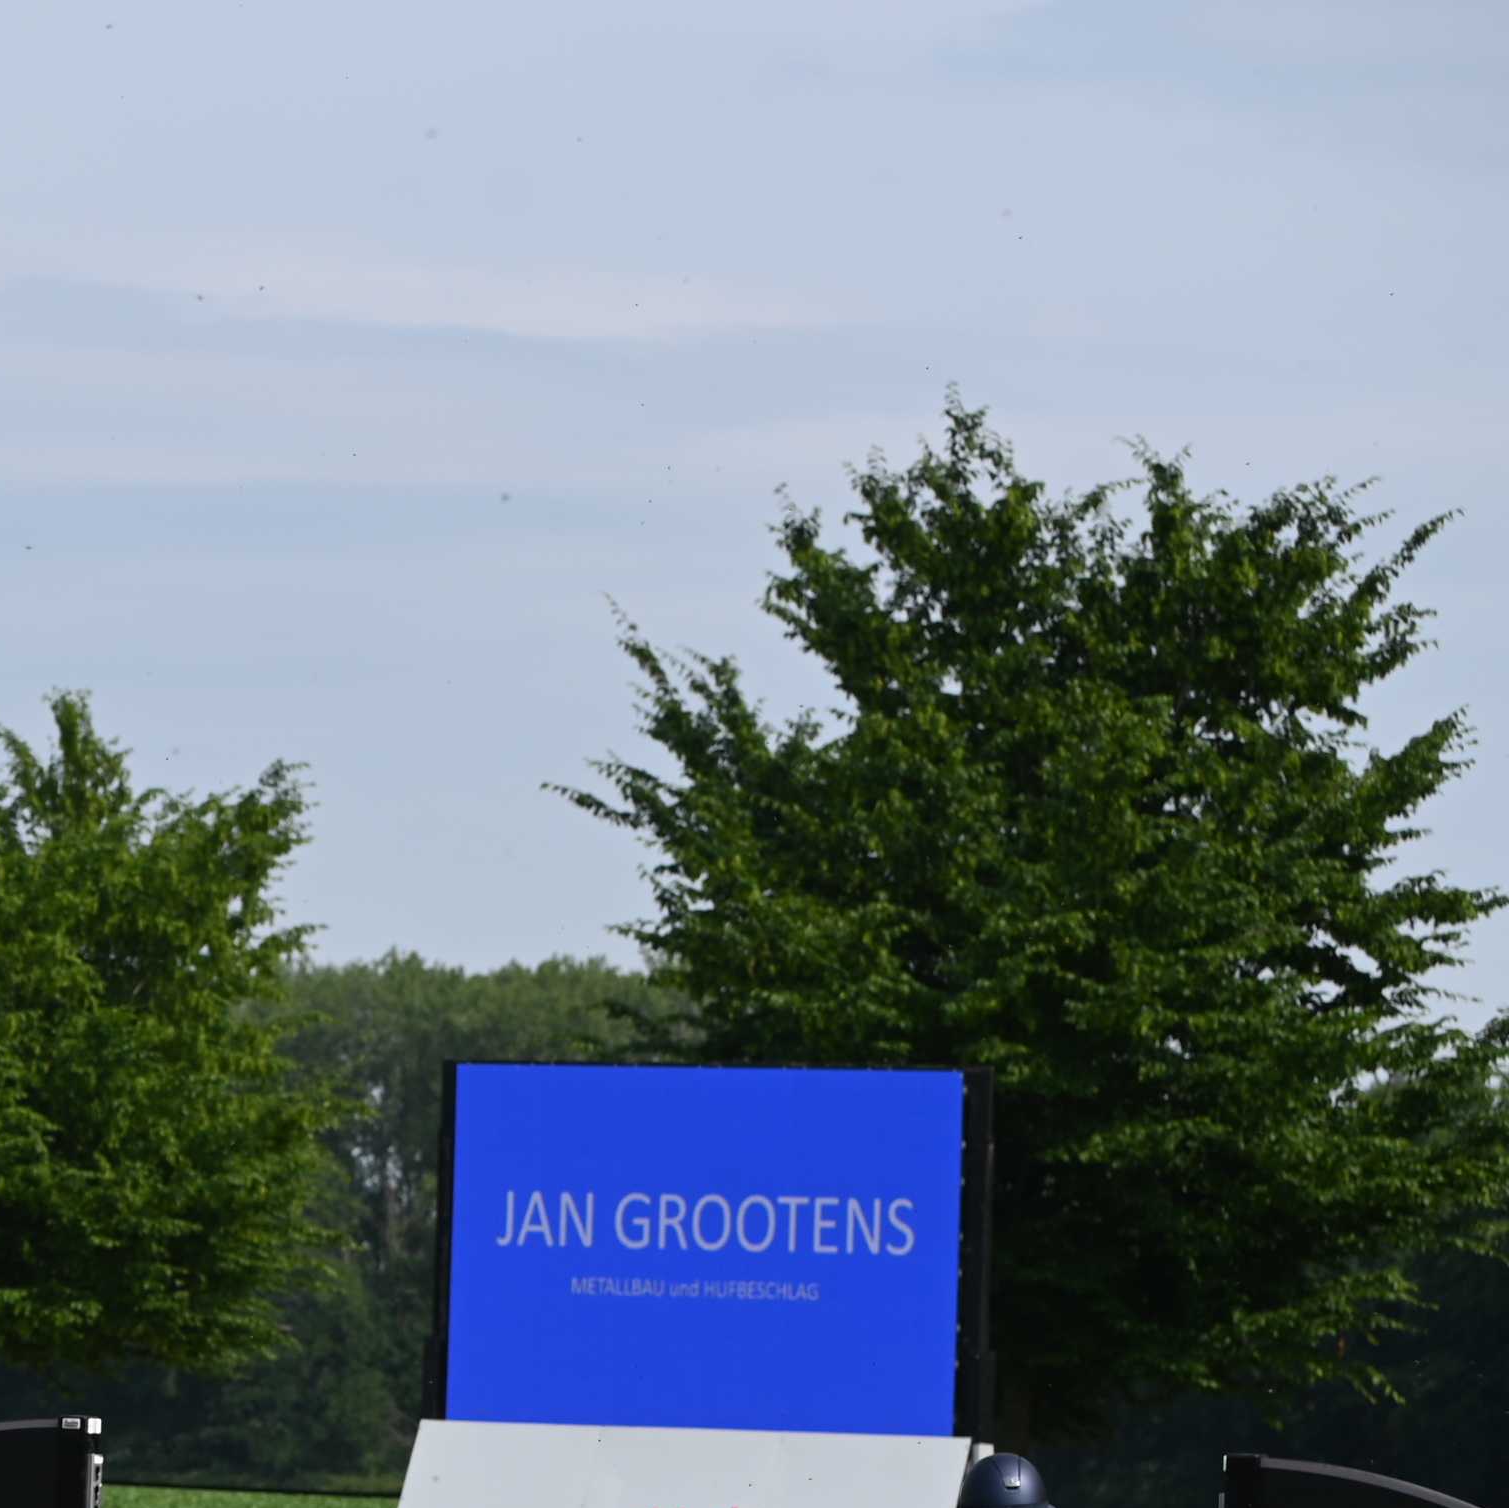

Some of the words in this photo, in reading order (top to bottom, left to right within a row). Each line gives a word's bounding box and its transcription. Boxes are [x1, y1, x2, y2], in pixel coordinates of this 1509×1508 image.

[496, 1191, 594, 1247] JAN
[614, 1192, 915, 1256] GROOTENS
[571, 1277, 665, 1297] METALLBAU
[669, 1282, 700, 1298] und
[704, 1280, 819, 1301] HUFBESCHLAG
